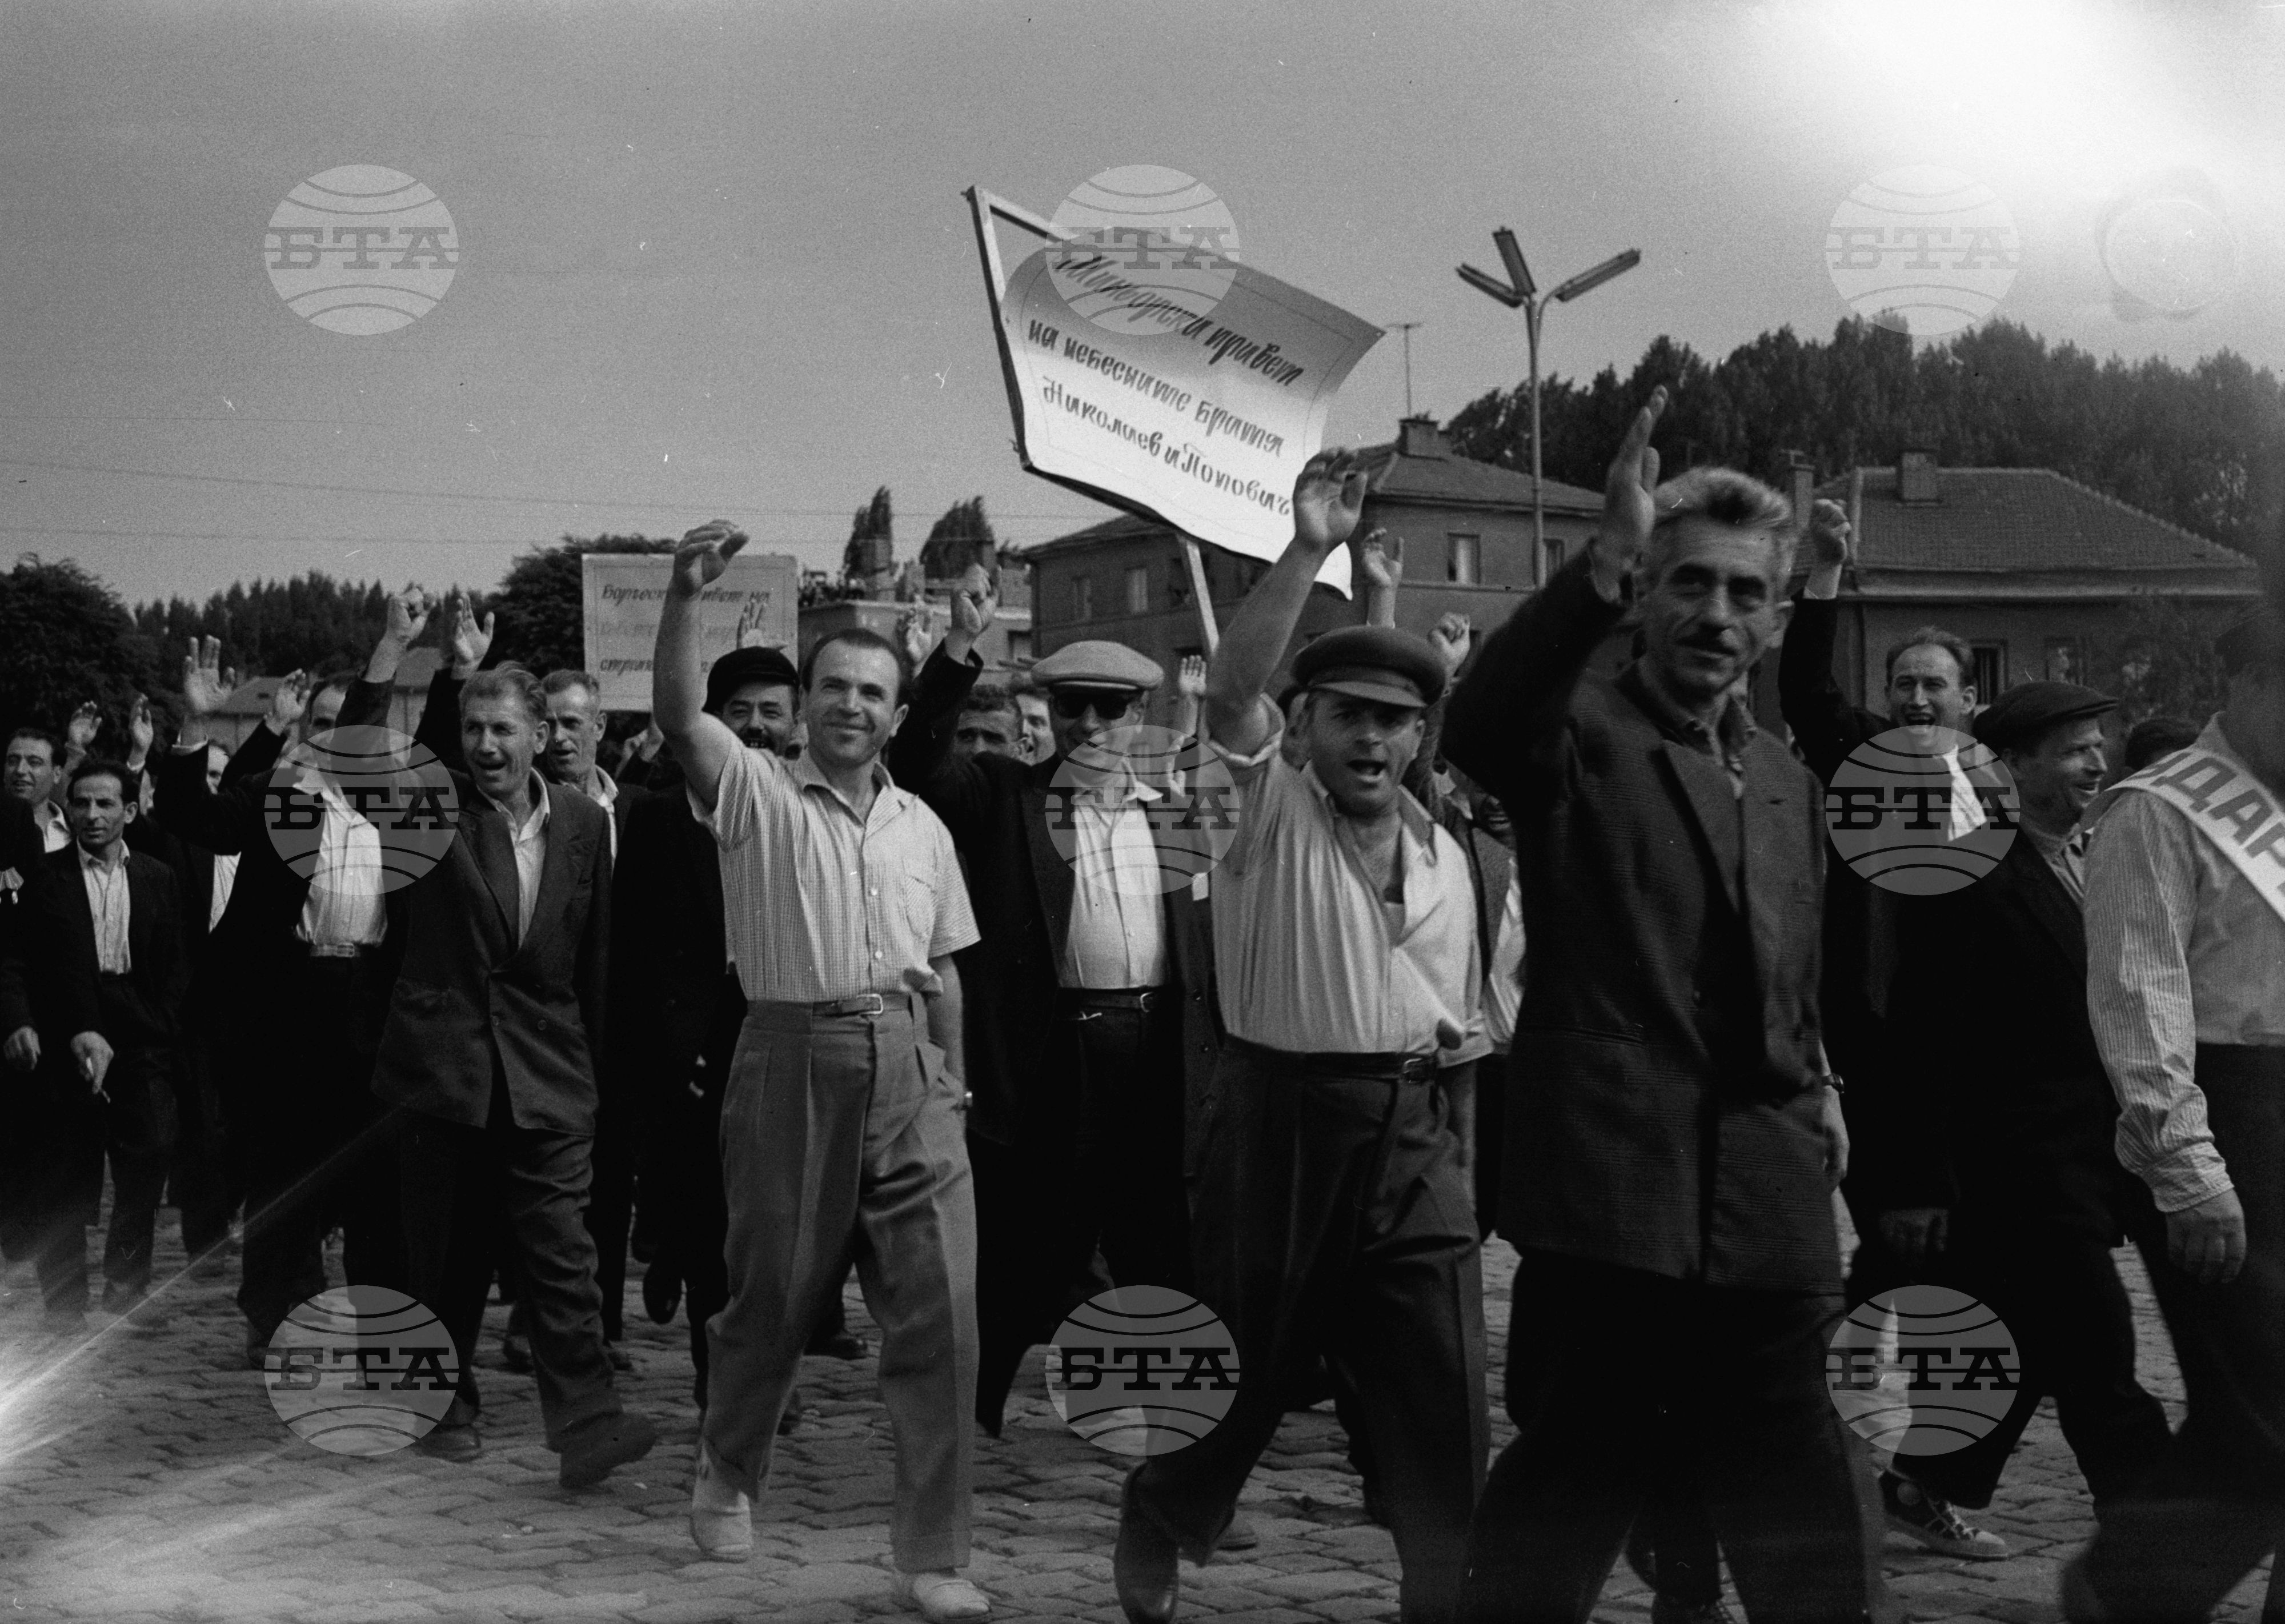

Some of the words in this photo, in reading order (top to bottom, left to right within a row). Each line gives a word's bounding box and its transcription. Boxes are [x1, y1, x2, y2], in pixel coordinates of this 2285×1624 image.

[1028, 318, 1060, 351] на
[1063, 336, 1192, 412] небесните
[1202, 327, 1305, 387] привет
[1042, 375, 1164, 457] Николаев
[1181, 443, 1291, 516] Попович
[2124, 751, 2285, 899] УДАР
